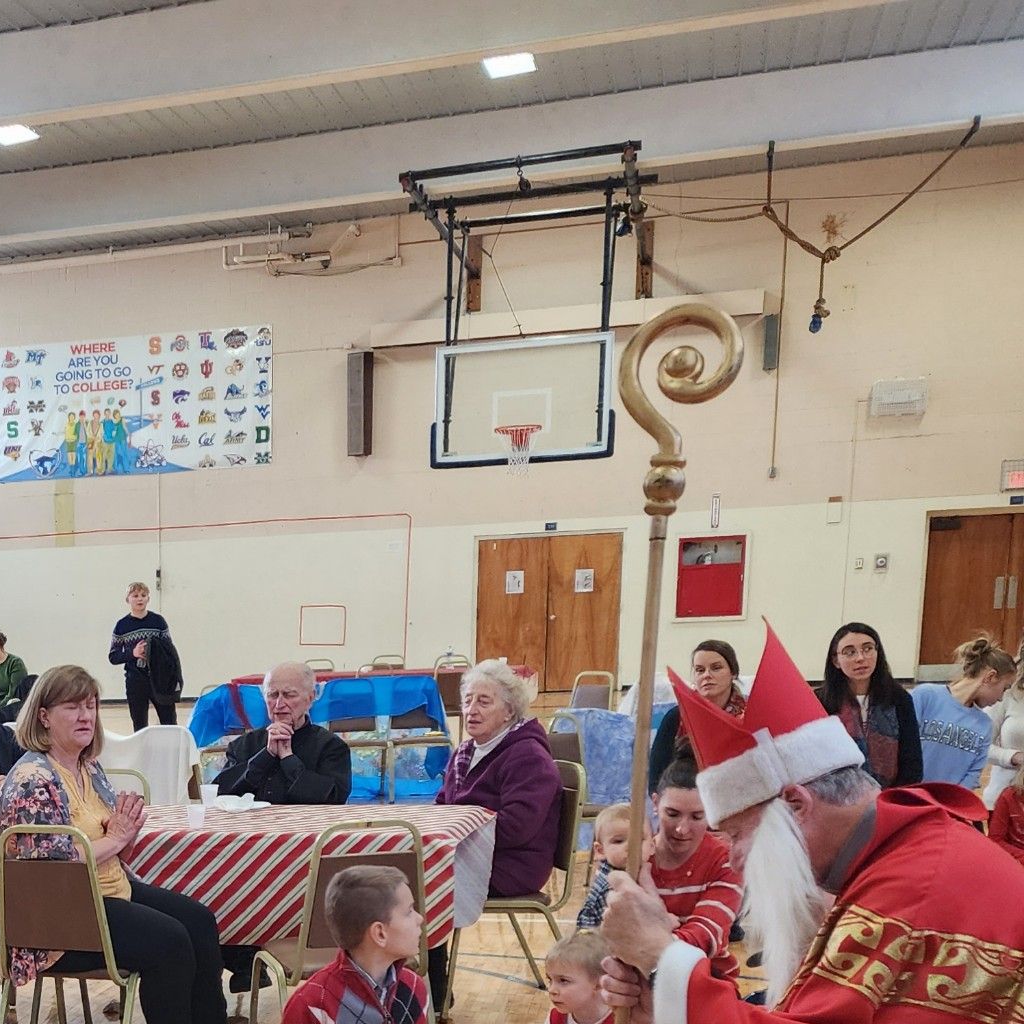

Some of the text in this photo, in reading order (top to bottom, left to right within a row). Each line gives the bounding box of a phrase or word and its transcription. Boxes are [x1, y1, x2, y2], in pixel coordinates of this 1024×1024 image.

[70, 342, 116, 355] WHERE
[149, 336, 161, 355] S
[68, 354, 118, 368] ARE YOU
[55, 366, 131, 382] GOING TO GO
[53, 384, 70, 395] TO
[71, 379, 134, 393] COLLEGE?
[7, 421, 19, 438] S
[255, 426, 270, 443] D
[198, 432, 216, 447] Cal
[919, 719, 944, 743] LOS
